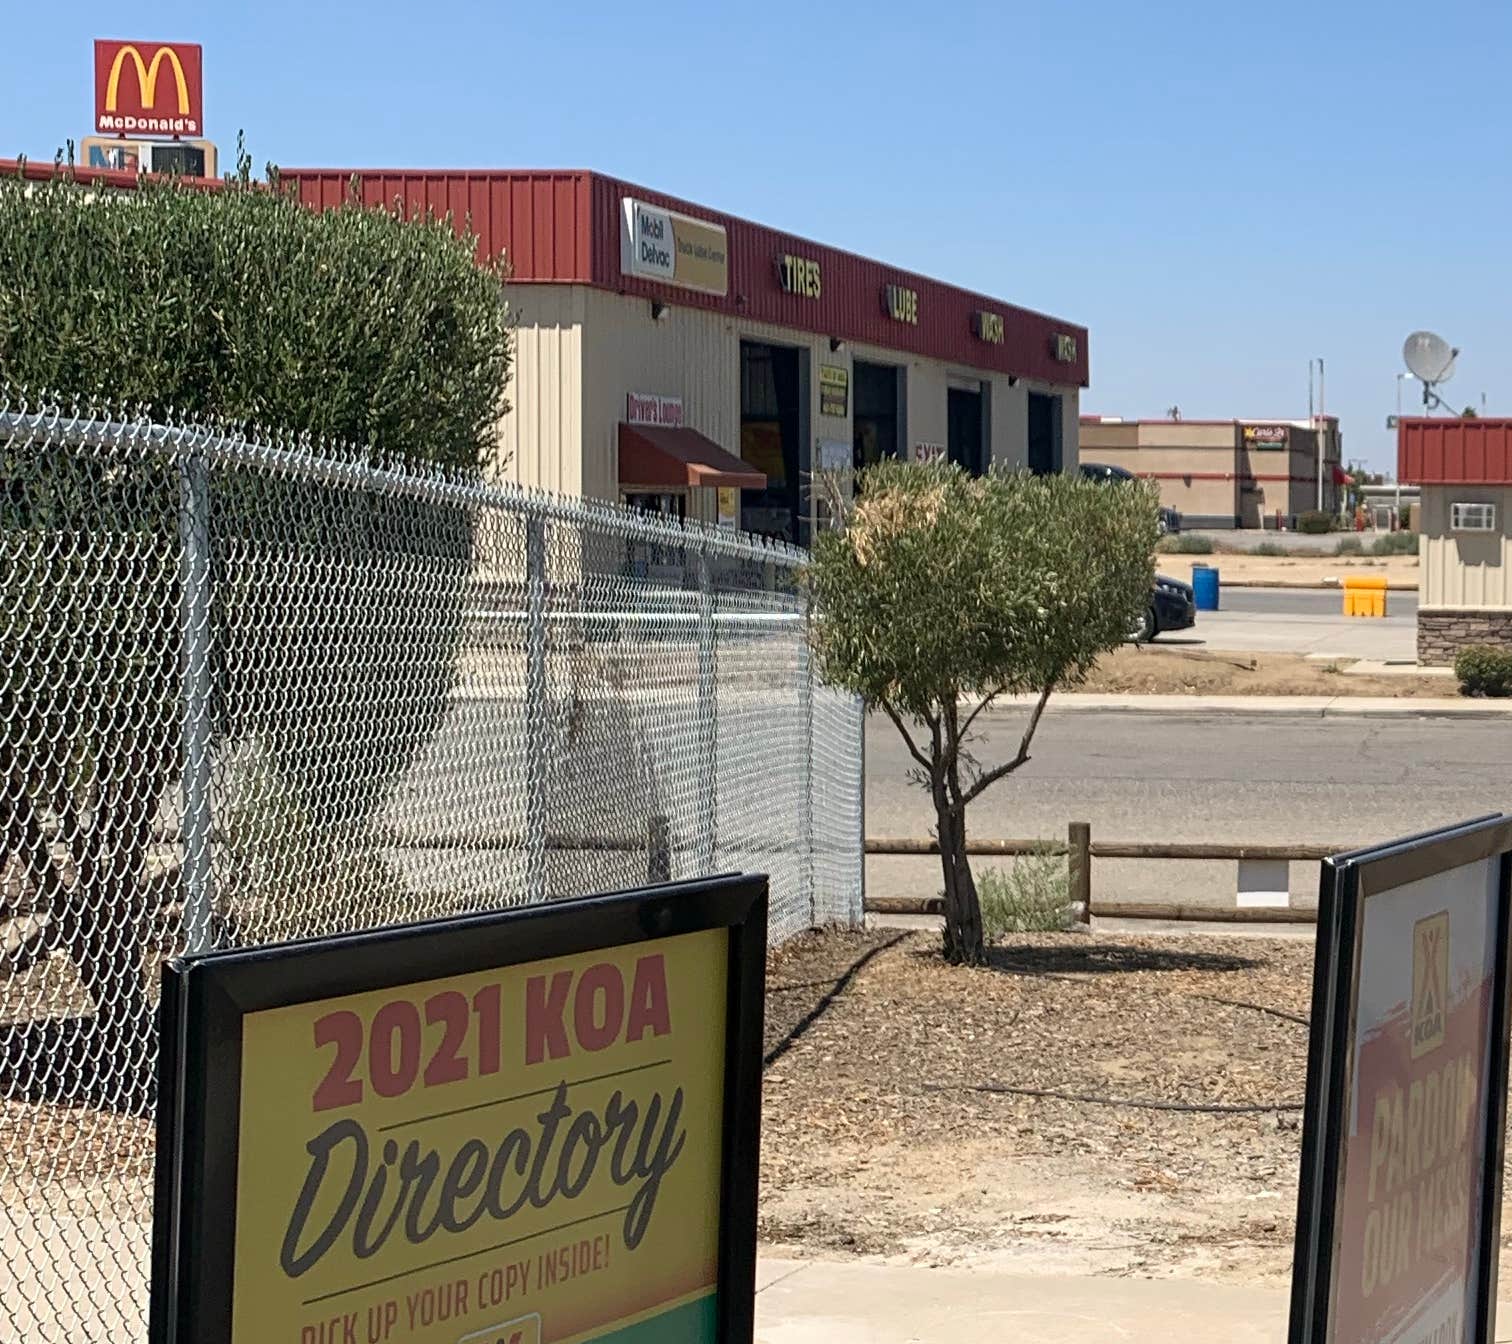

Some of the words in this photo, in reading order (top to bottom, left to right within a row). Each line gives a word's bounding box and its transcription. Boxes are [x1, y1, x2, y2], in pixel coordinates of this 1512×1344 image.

[99, 115, 197, 132] McDonald's
[641, 214, 664, 240] Mobil
[641, 242, 670, 268] Delvac
[785, 254, 822, 300] TIRES
[892, 286, 918, 326] LUBE
[312, 982, 502, 1112] 2021
[524, 954, 672, 1066] KOA
[1413, 1011, 1443, 1046] KOA
[1367, 1051, 1476, 1203] PARDON
[280, 1080, 687, 1278] Directory
[1362, 1191, 1413, 1298] OUR
[367, 1300, 398, 1344] UP
[406, 1278, 469, 1331] YOUR
[478, 1259, 531, 1310] COPY
[537, 1233, 611, 1291] INSIDE!
